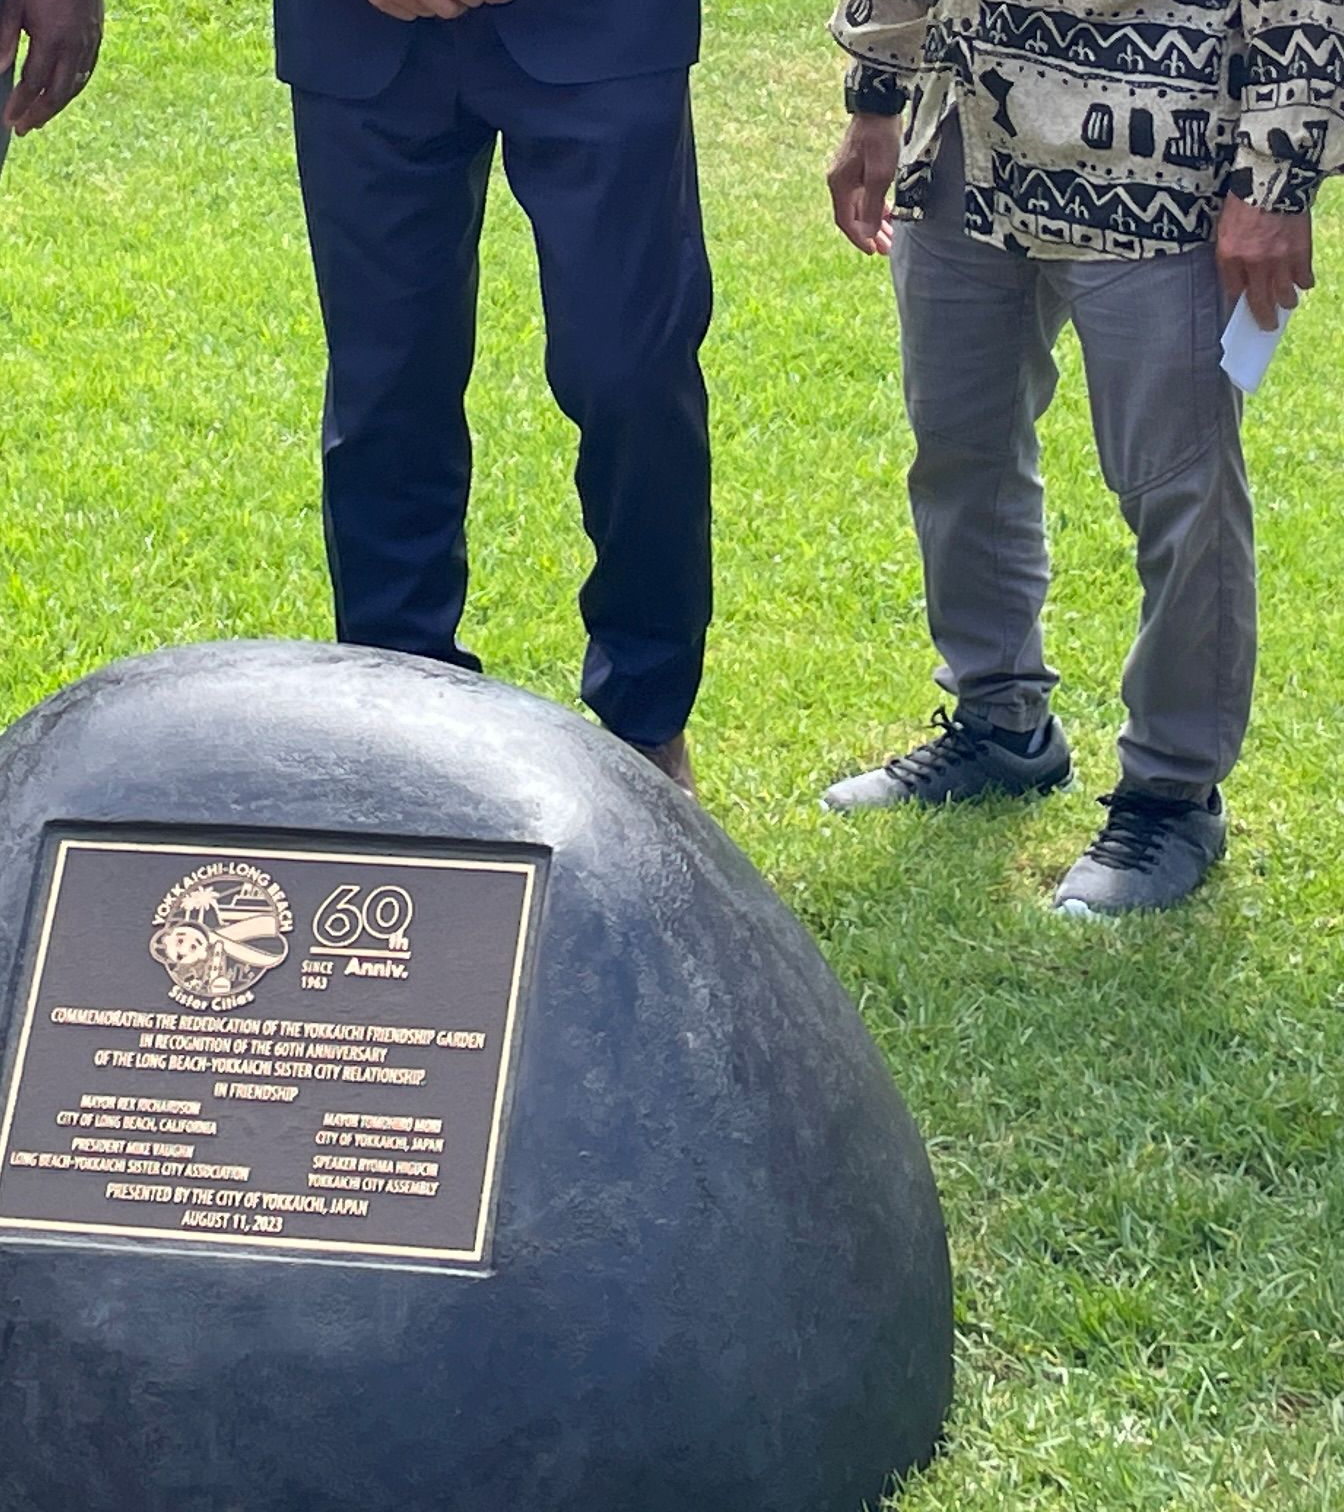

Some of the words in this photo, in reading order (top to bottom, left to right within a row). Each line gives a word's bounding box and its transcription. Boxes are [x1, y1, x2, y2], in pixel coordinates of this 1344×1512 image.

[266, 877, 294, 933] BEACH
[301, 959, 334, 975] SINCE
[343, 957, 409, 979] Anniv.
[301, 975, 328, 990] 1963
[167, 984, 207, 1010] Sister
[211, 990, 255, 1011] Cities
[51, 1007, 154, 1029] COMMEMORATING
[156, 1013, 177, 1029] THE
[178, 1014, 260, 1035] REDEDICATION
[262, 1021, 279, 1035] OF
[280, 1022, 304, 1037] THE
[304, 1023, 365, 1040] YOKKAICHI
[366, 1026, 435, 1045] FRIENDSHIP
[436, 1031, 486, 1048] GARDEN
[140, 1033, 154, 1048] IN
[155, 1034, 232, 1053] RECOGNITION
[233, 1038, 250, 1054] OF
[250, 1040, 272, 1055] THE
[274, 1041, 305, 1057] 60TH
[306, 1043, 388, 1062] ANNIVERSARY
[94, 1049, 113, 1066] OF
[113, 1051, 135, 1067] THE
[136, 1054, 166, 1069] LONG
[168, 1054, 272, 1076] BEACH-YOKKAICHI
[274, 1061, 312, 1079] SISTER
[314, 1064, 342, 1080] CITY
[213, 1082, 229, 1097] IN
[229, 1083, 299, 1102] FRIENDSHIP
[80, 1094, 116, 1109] MAYOR
[117, 1096, 136, 1111] REX
[137, 1097, 202, 1115] RICHARDSON
[56, 1111, 78, 1126] CITY
[79, 1113, 94, 1127] OF
[95, 1114, 121, 1129] LONG
[159, 1118, 216, 1135] CALIFORNIA
[322, 1112, 360, 1128] MAYOR
[72, 1137, 126, 1153] PRESIDENT
[126, 1140, 151, 1155] MIKE
[315, 1130, 338, 1145] CITY
[339, 1132, 353, 1146] OF
[354, 1134, 409, 1152] YOKKAICHI,
[410, 1138, 444, 1152] JAPAN
[10, 1151, 38, 1166] LONG
[39, 1153, 126, 1172] BEACH-YOKKAICHI
[127, 1159, 160, 1174] SISTER
[161, 1161, 185, 1177] CITY
[184, 1163, 251, 1182] ASSOCIATION
[312, 1155, 357, 1171] SPEAKER
[358, 1158, 394, 1173] RYOMA
[395, 1160, 439, 1177] HIGUCHI
[308, 1173, 360, 1189] YOKKAICHI
[362, 1177, 386, 1192] CITY
[385, 1179, 440, 1196] ASSEMBLY
[105, 1182, 172, 1202] PRESENTED
[173, 1188, 192, 1204] BY
[192, 1188, 215, 1205] THE
[215, 1189, 244, 1207] CITY
[244, 1191, 261, 1208] OF
[262, 1193, 327, 1215] YOKKAICHI,
[329, 1198, 369, 1217] JAPAN
[181, 1210, 230, 1228] AUGUST
[233, 1214, 251, 1230] 11,
[252, 1215, 283, 1232] 2023
